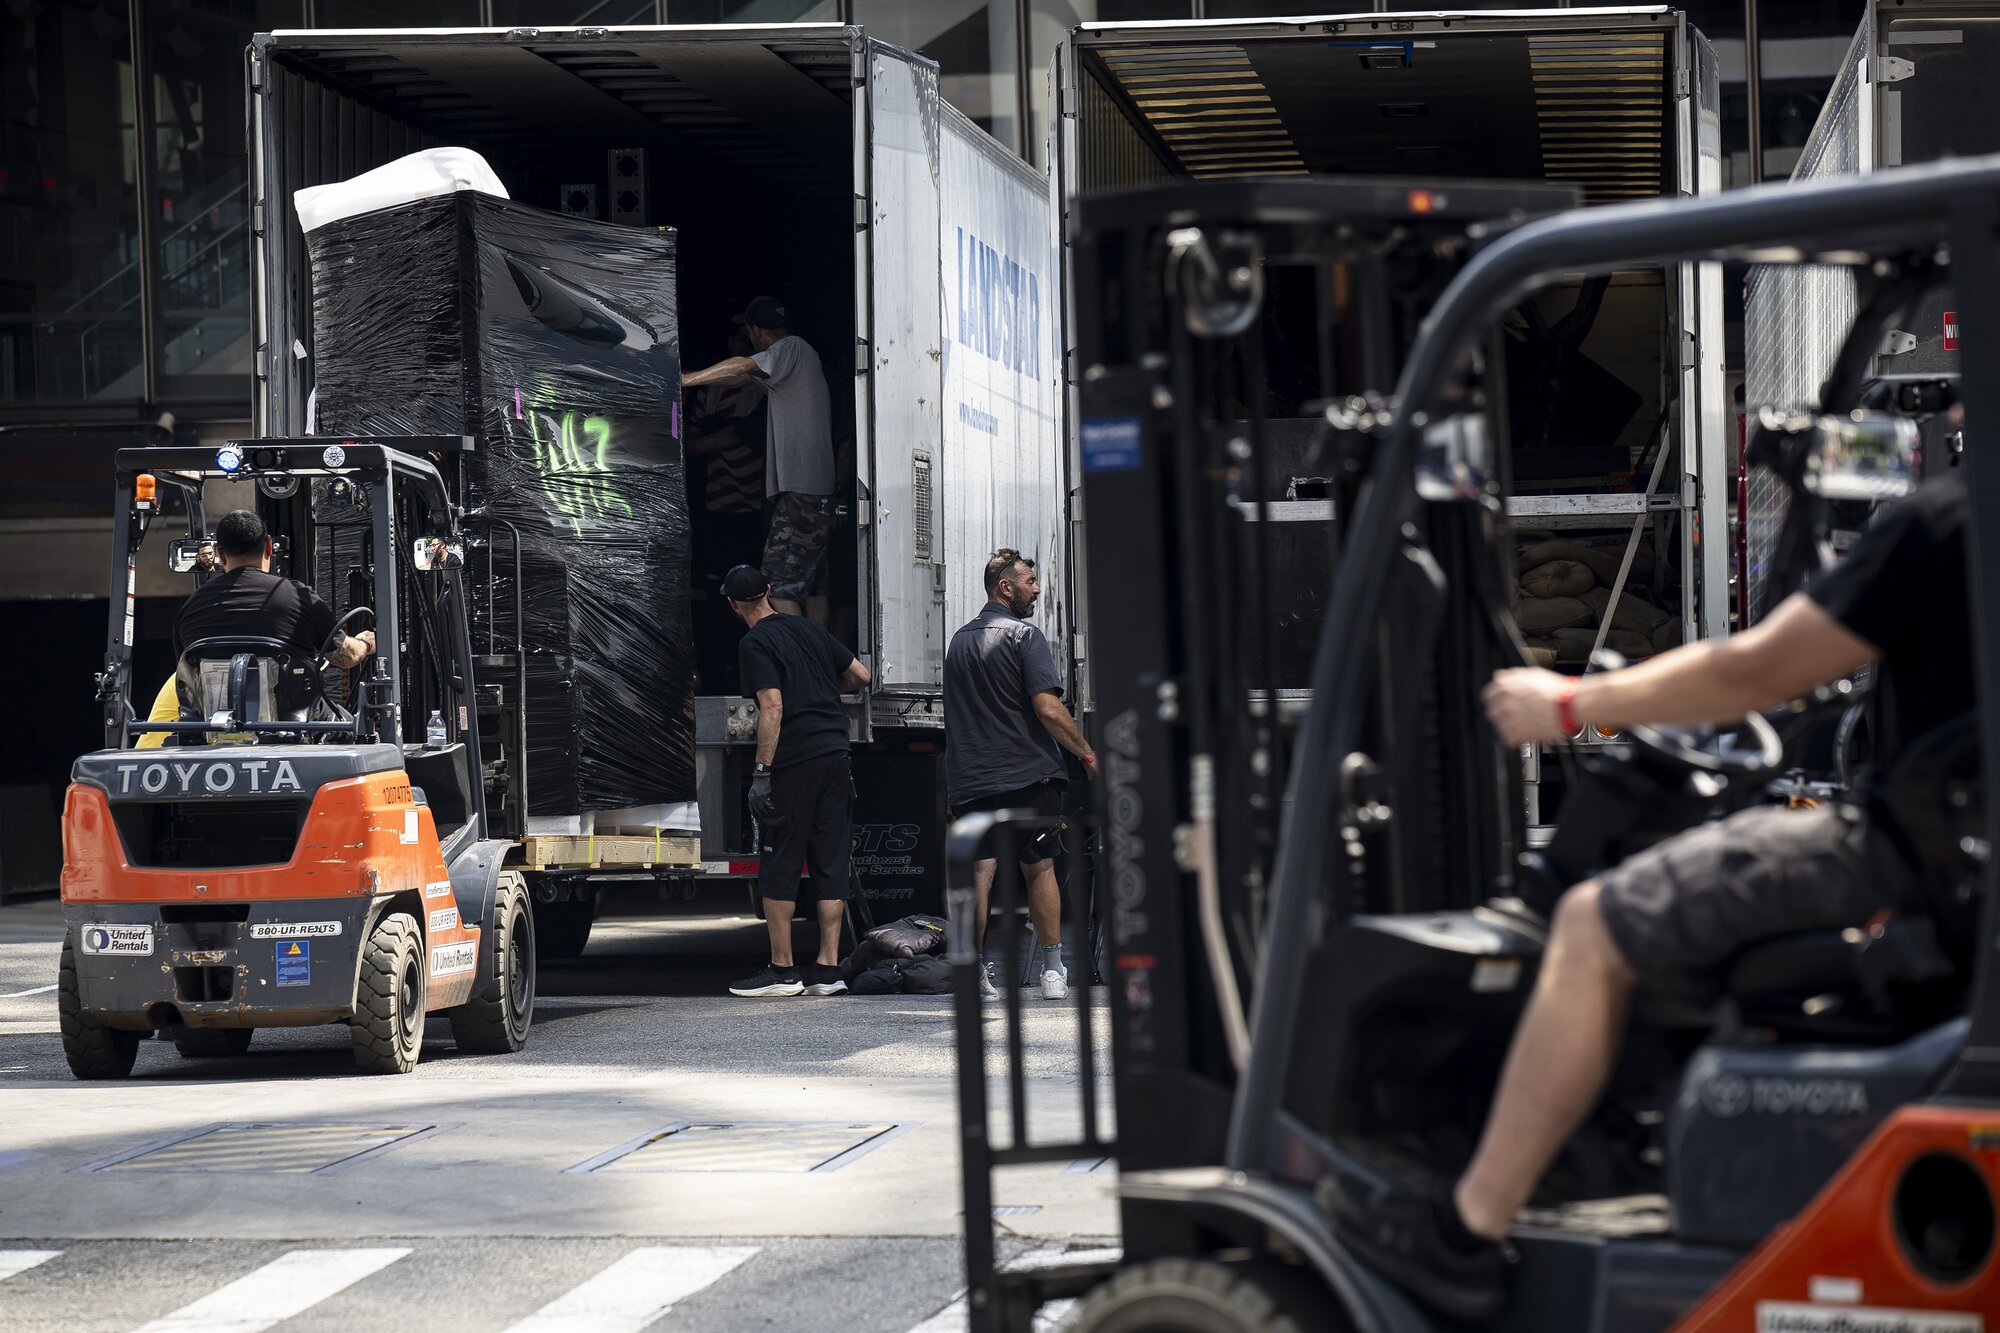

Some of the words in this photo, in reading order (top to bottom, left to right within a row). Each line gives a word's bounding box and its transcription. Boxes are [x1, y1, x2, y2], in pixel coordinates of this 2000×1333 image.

[957, 226, 1040, 382] LANDSTAR
[116, 761, 303, 794] TOYOTA
[1104, 707, 1149, 946] TOYOTA
[869, 865, 925, 875] Service
[111, 930, 146, 940] United
[257, 924, 336, 936] 800-UR-RENTS
[111, 940, 149, 951] Rentals
[1751, 1078, 1868, 1114] TOYOTA
